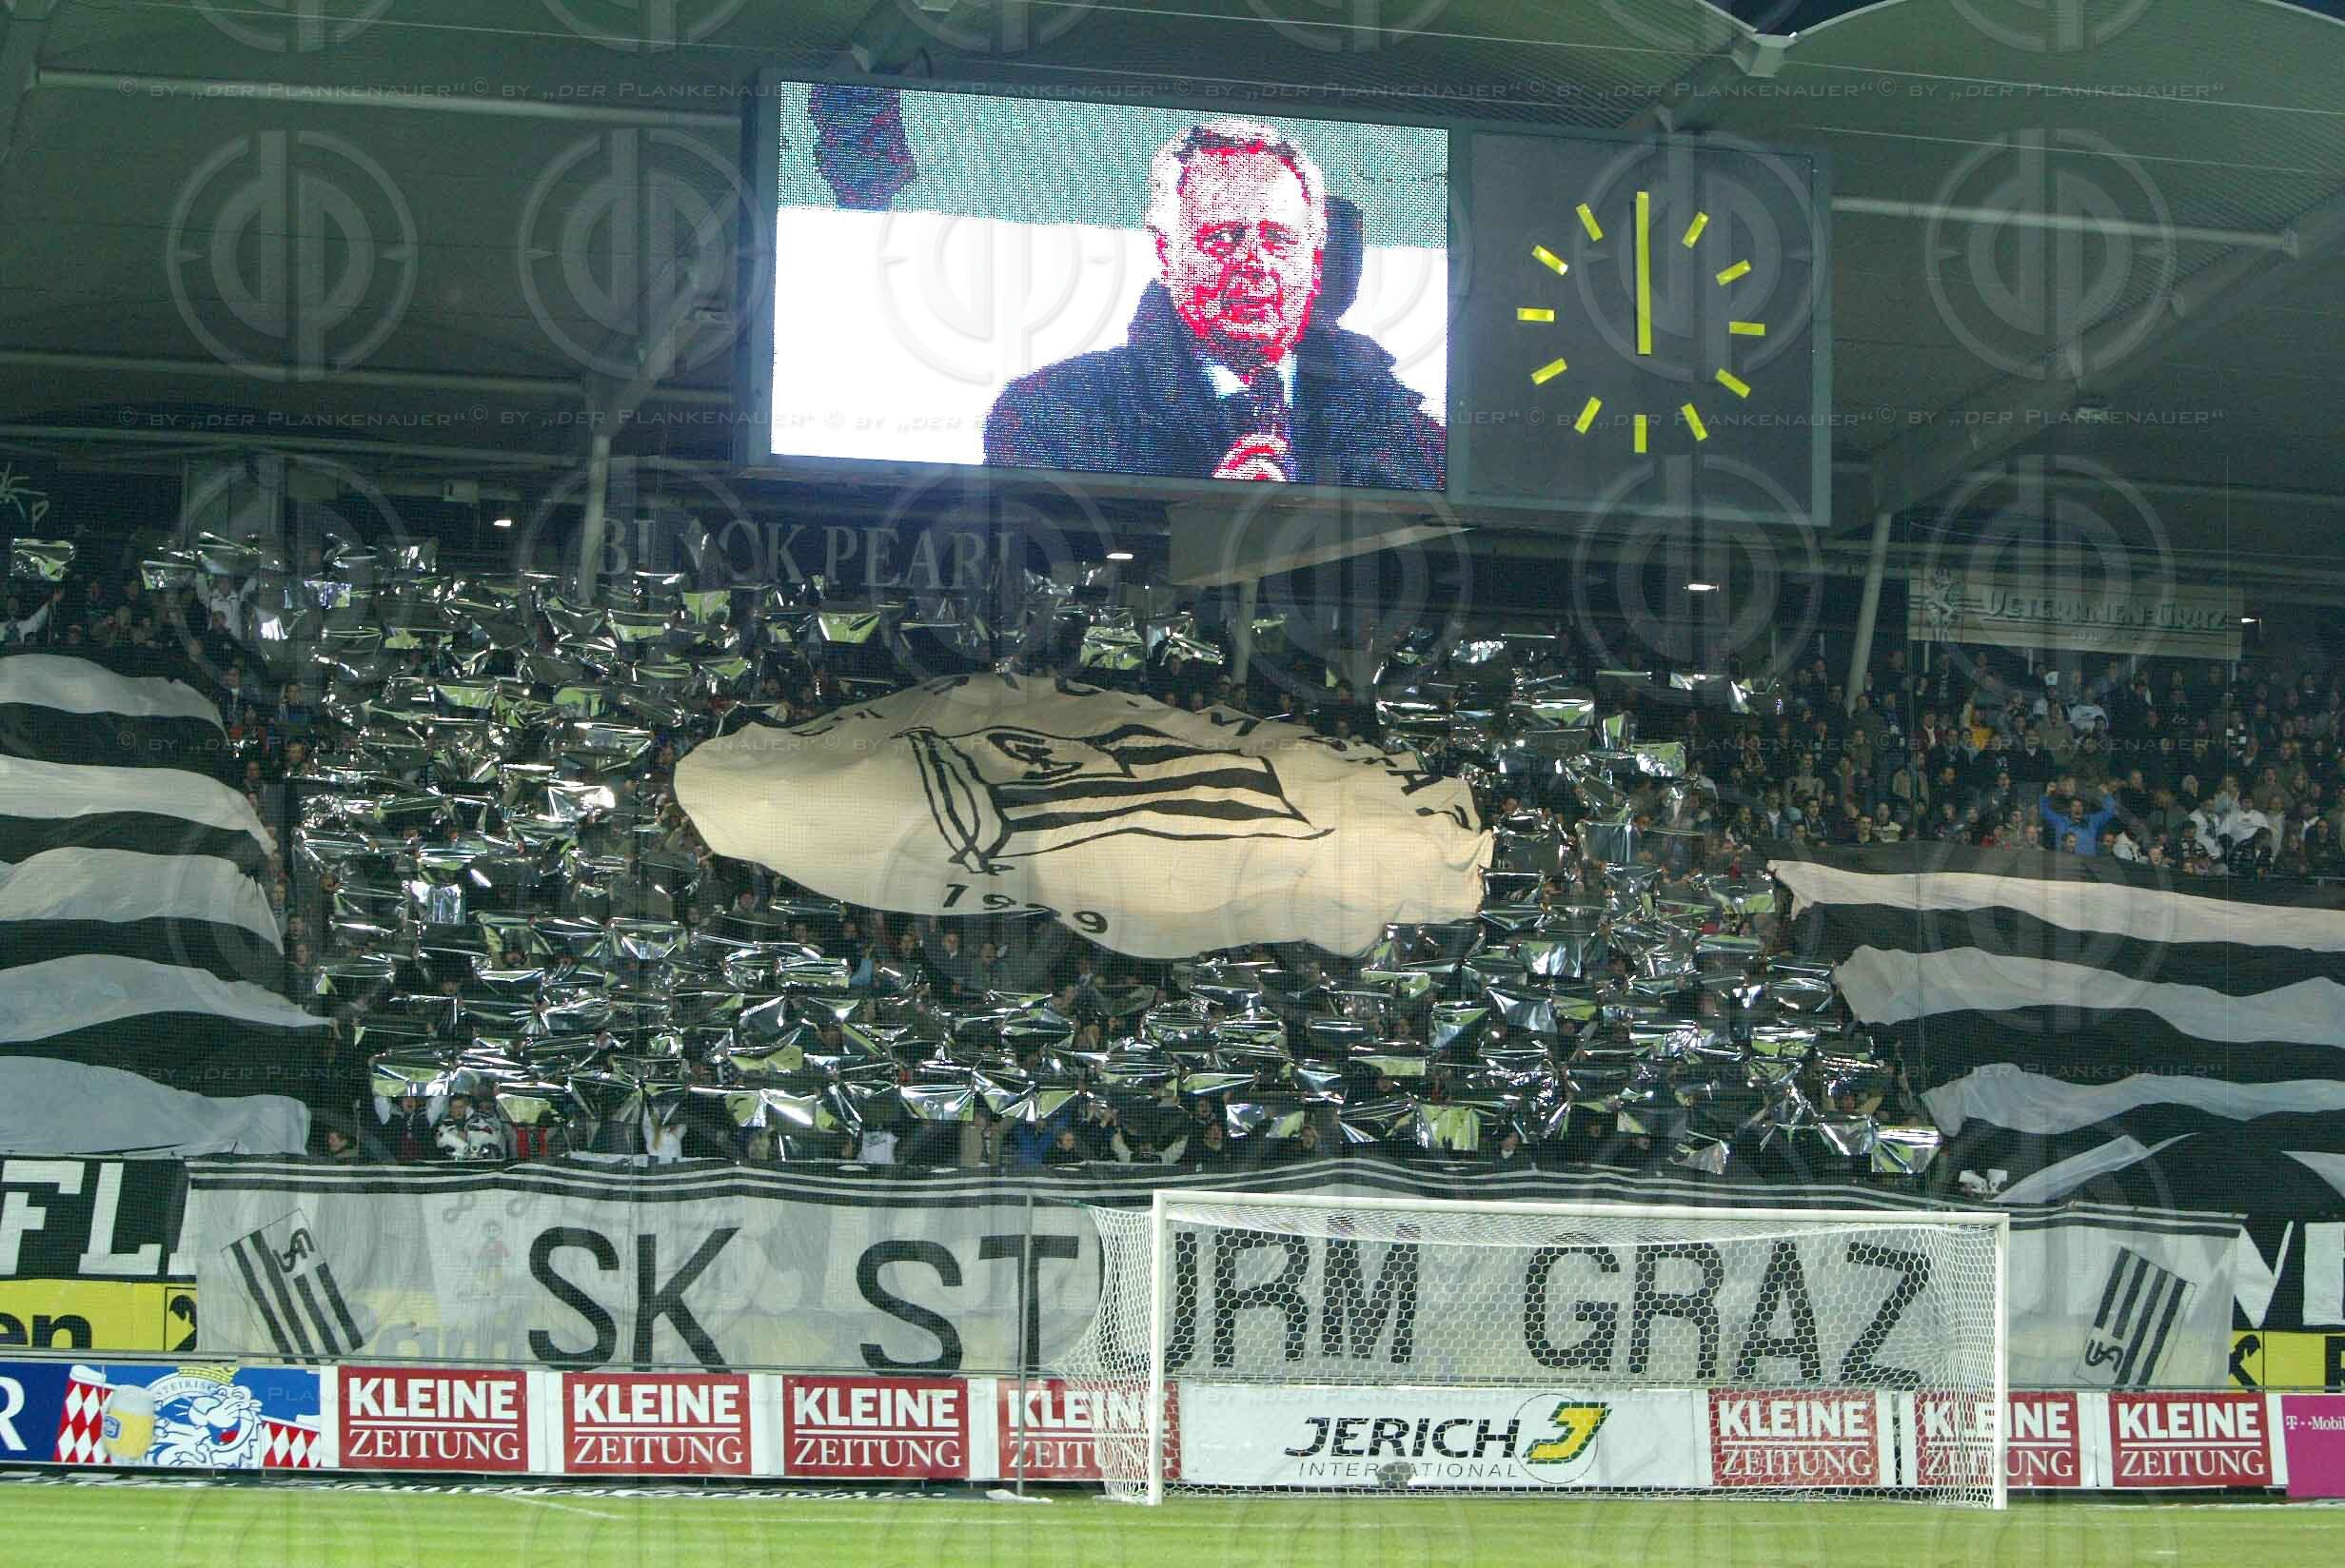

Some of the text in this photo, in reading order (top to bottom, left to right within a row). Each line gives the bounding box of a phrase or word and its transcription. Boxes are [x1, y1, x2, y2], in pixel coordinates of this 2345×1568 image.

[527, 1217, 1931, 1389] SK STURM GRAZ
[346, 1377, 518, 1421] KLEINE
[573, 1383, 742, 1424] KLEINE
[792, 1386, 956, 1427] KLEINE
[1285, 1417, 1521, 1458] JERICH
[1718, 1399, 1869, 1439] KLEINE
[2118, 1401, 2262, 1439] KLEINE
[348, 1429, 520, 1460] ZEITUNG
[574, 1434, 743, 1464] ZEITUNG
[794, 1438, 961, 1468] ZEITUNG
[1721, 1448, 1873, 1478] ZEITUNG
[2119, 1449, 2265, 1477] ZEITUNG
[1299, 1460, 1517, 1479] INTERATIONAL
